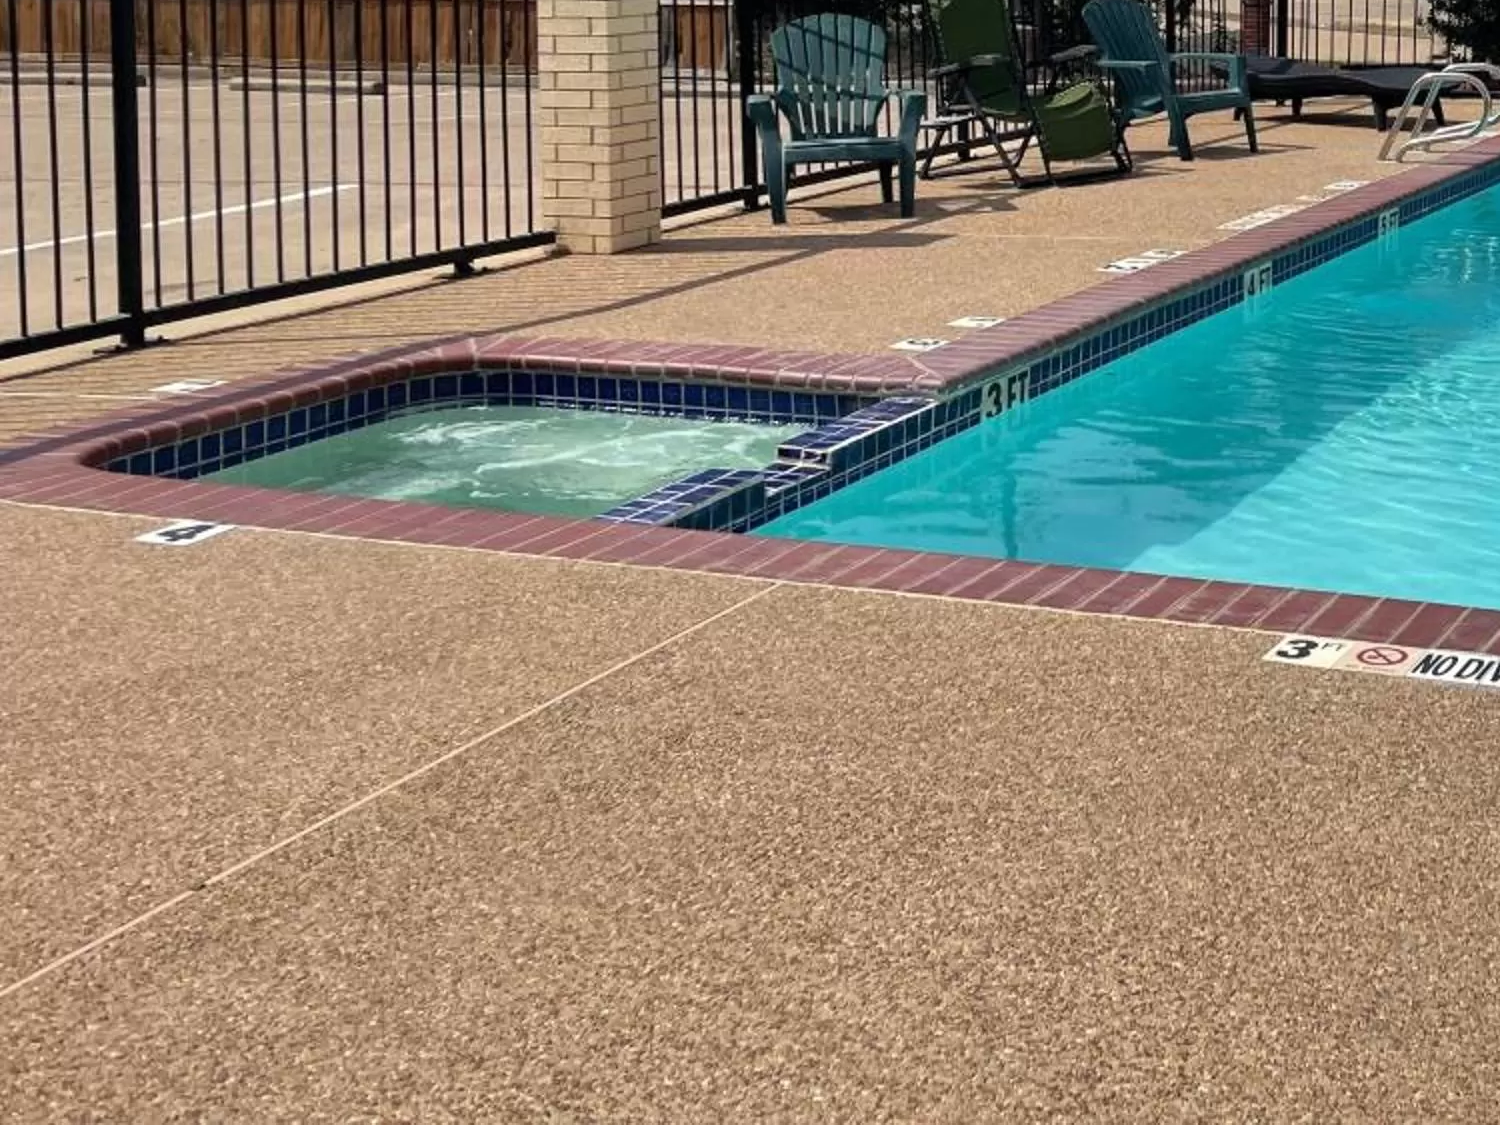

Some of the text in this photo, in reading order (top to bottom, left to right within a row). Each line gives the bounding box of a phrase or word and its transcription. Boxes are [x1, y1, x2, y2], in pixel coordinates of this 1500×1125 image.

[985, 370, 1029, 418] 3 FT
[1276, 639, 1319, 660] 3
[1321, 641, 1346, 653] FT
[1412, 653, 1459, 676] NO
